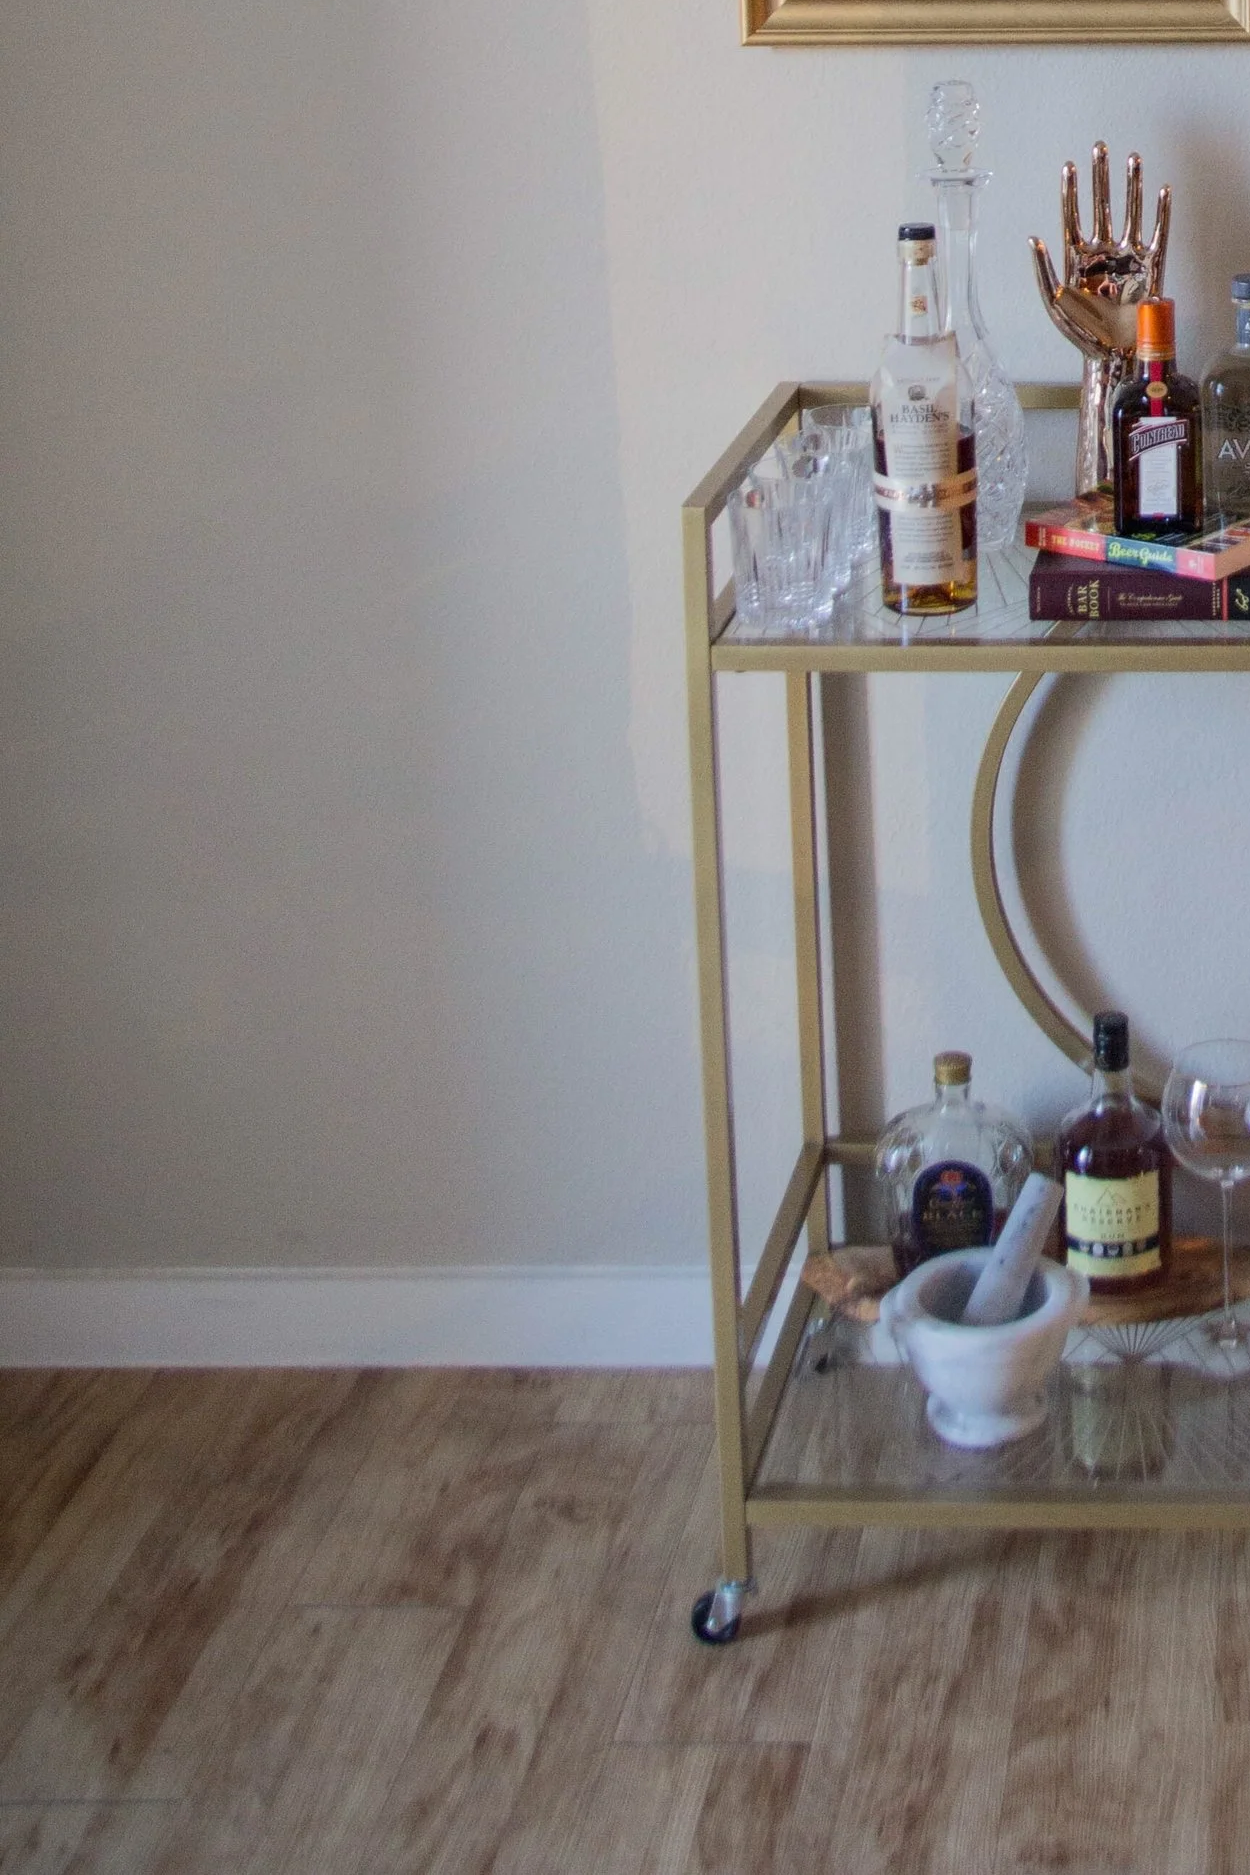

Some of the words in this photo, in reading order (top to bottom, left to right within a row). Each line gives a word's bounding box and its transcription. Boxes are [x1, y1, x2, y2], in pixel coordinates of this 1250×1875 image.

[890, 411, 950, 423] HAYDEN'S
[902, 404, 938, 414] BASIL
[1131, 422, 1186, 454] COINTREAU
[1108, 541, 1139, 559] Beer
[1139, 547, 1174, 566] Guide
[1077, 585, 1088, 614] BAR
[1089, 579, 1100, 619] BOOK
